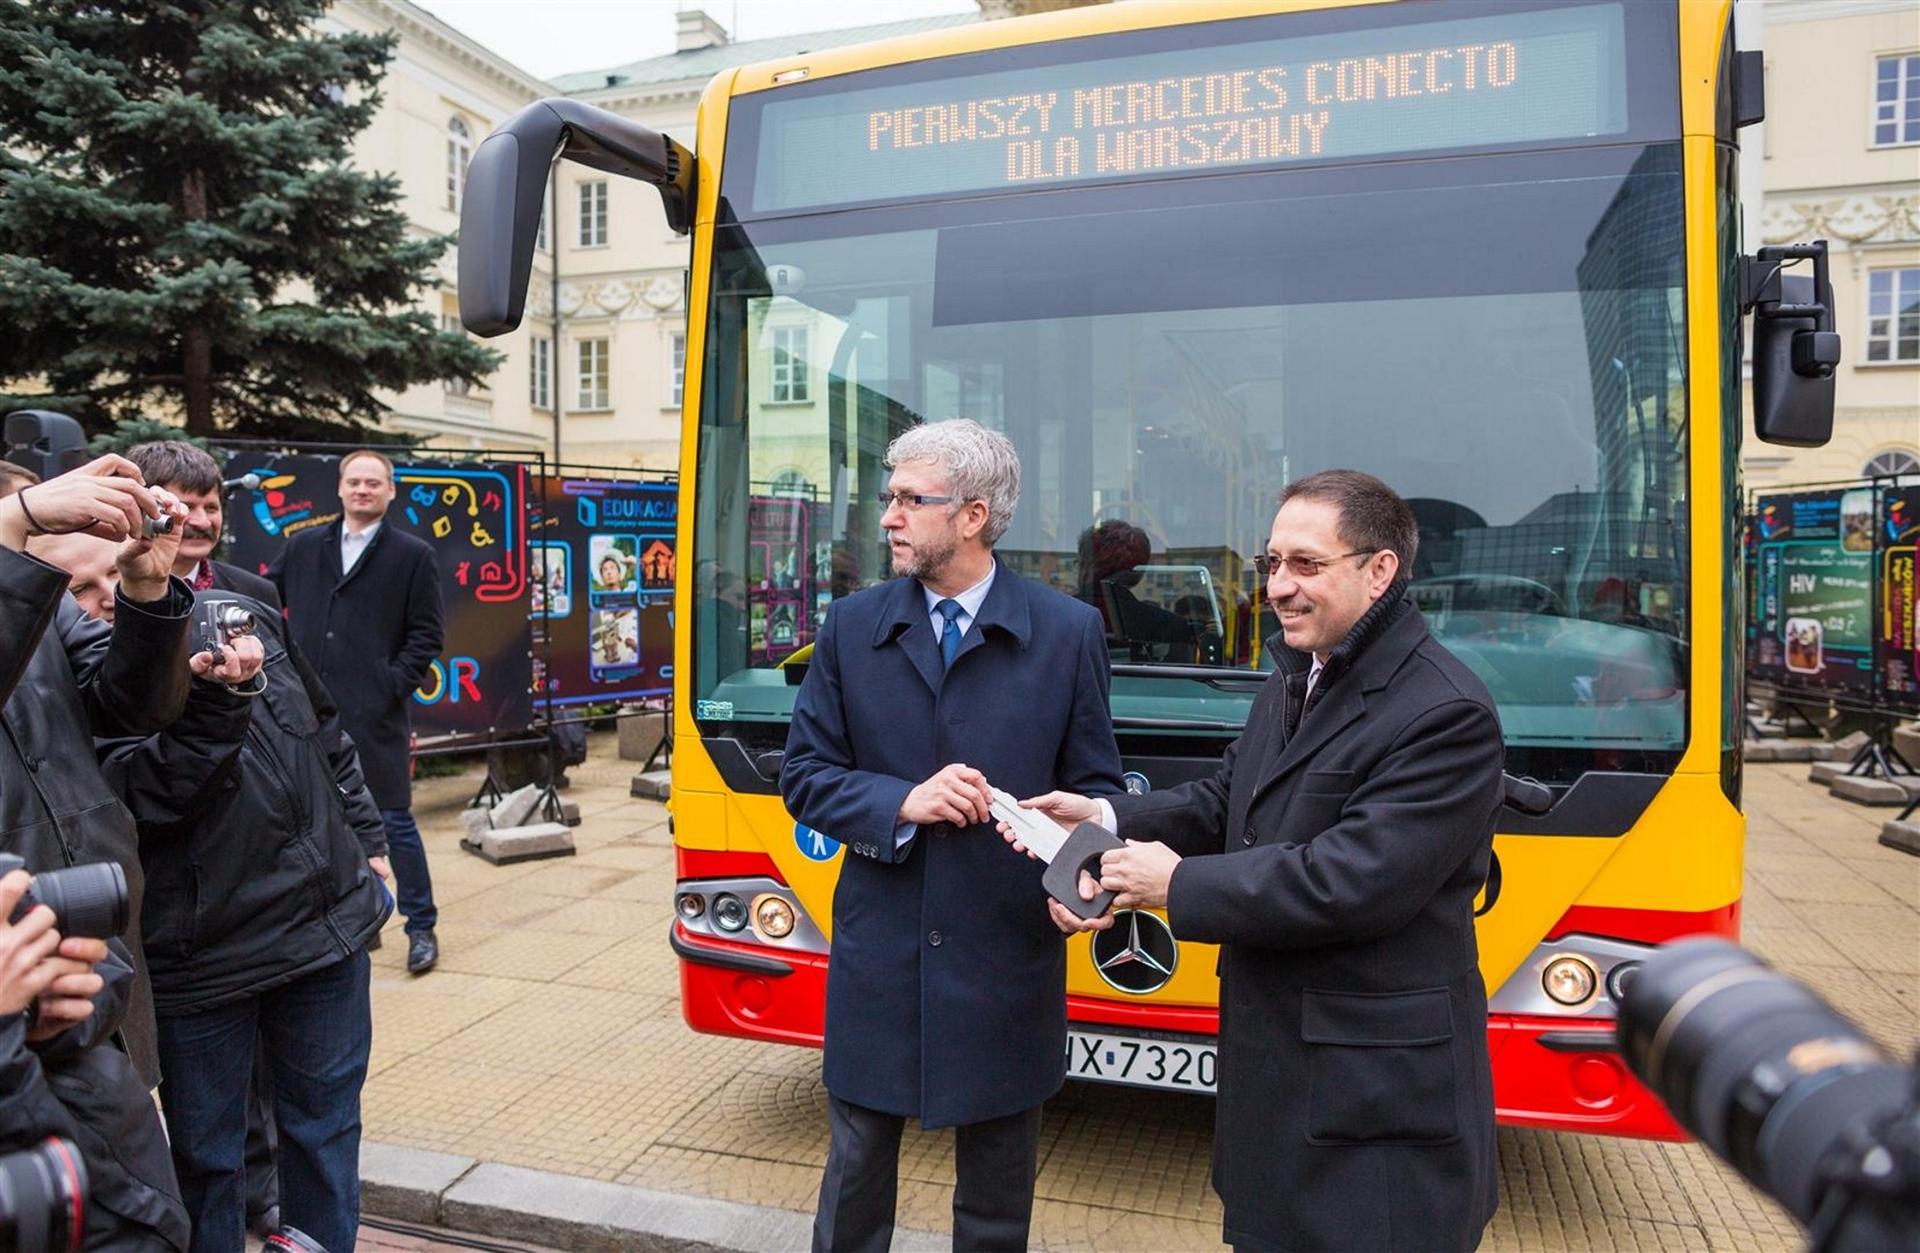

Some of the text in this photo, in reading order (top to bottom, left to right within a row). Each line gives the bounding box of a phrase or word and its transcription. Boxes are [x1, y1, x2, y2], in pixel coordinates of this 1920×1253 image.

[869, 42, 1516, 151] PIERWSZY MERCEDES CONECTO
[1007, 111, 1329, 181] DLA WARSZAWY
[1790, 574, 1816, 594] HIV
[1120, 1041, 1217, 1087] 7320
